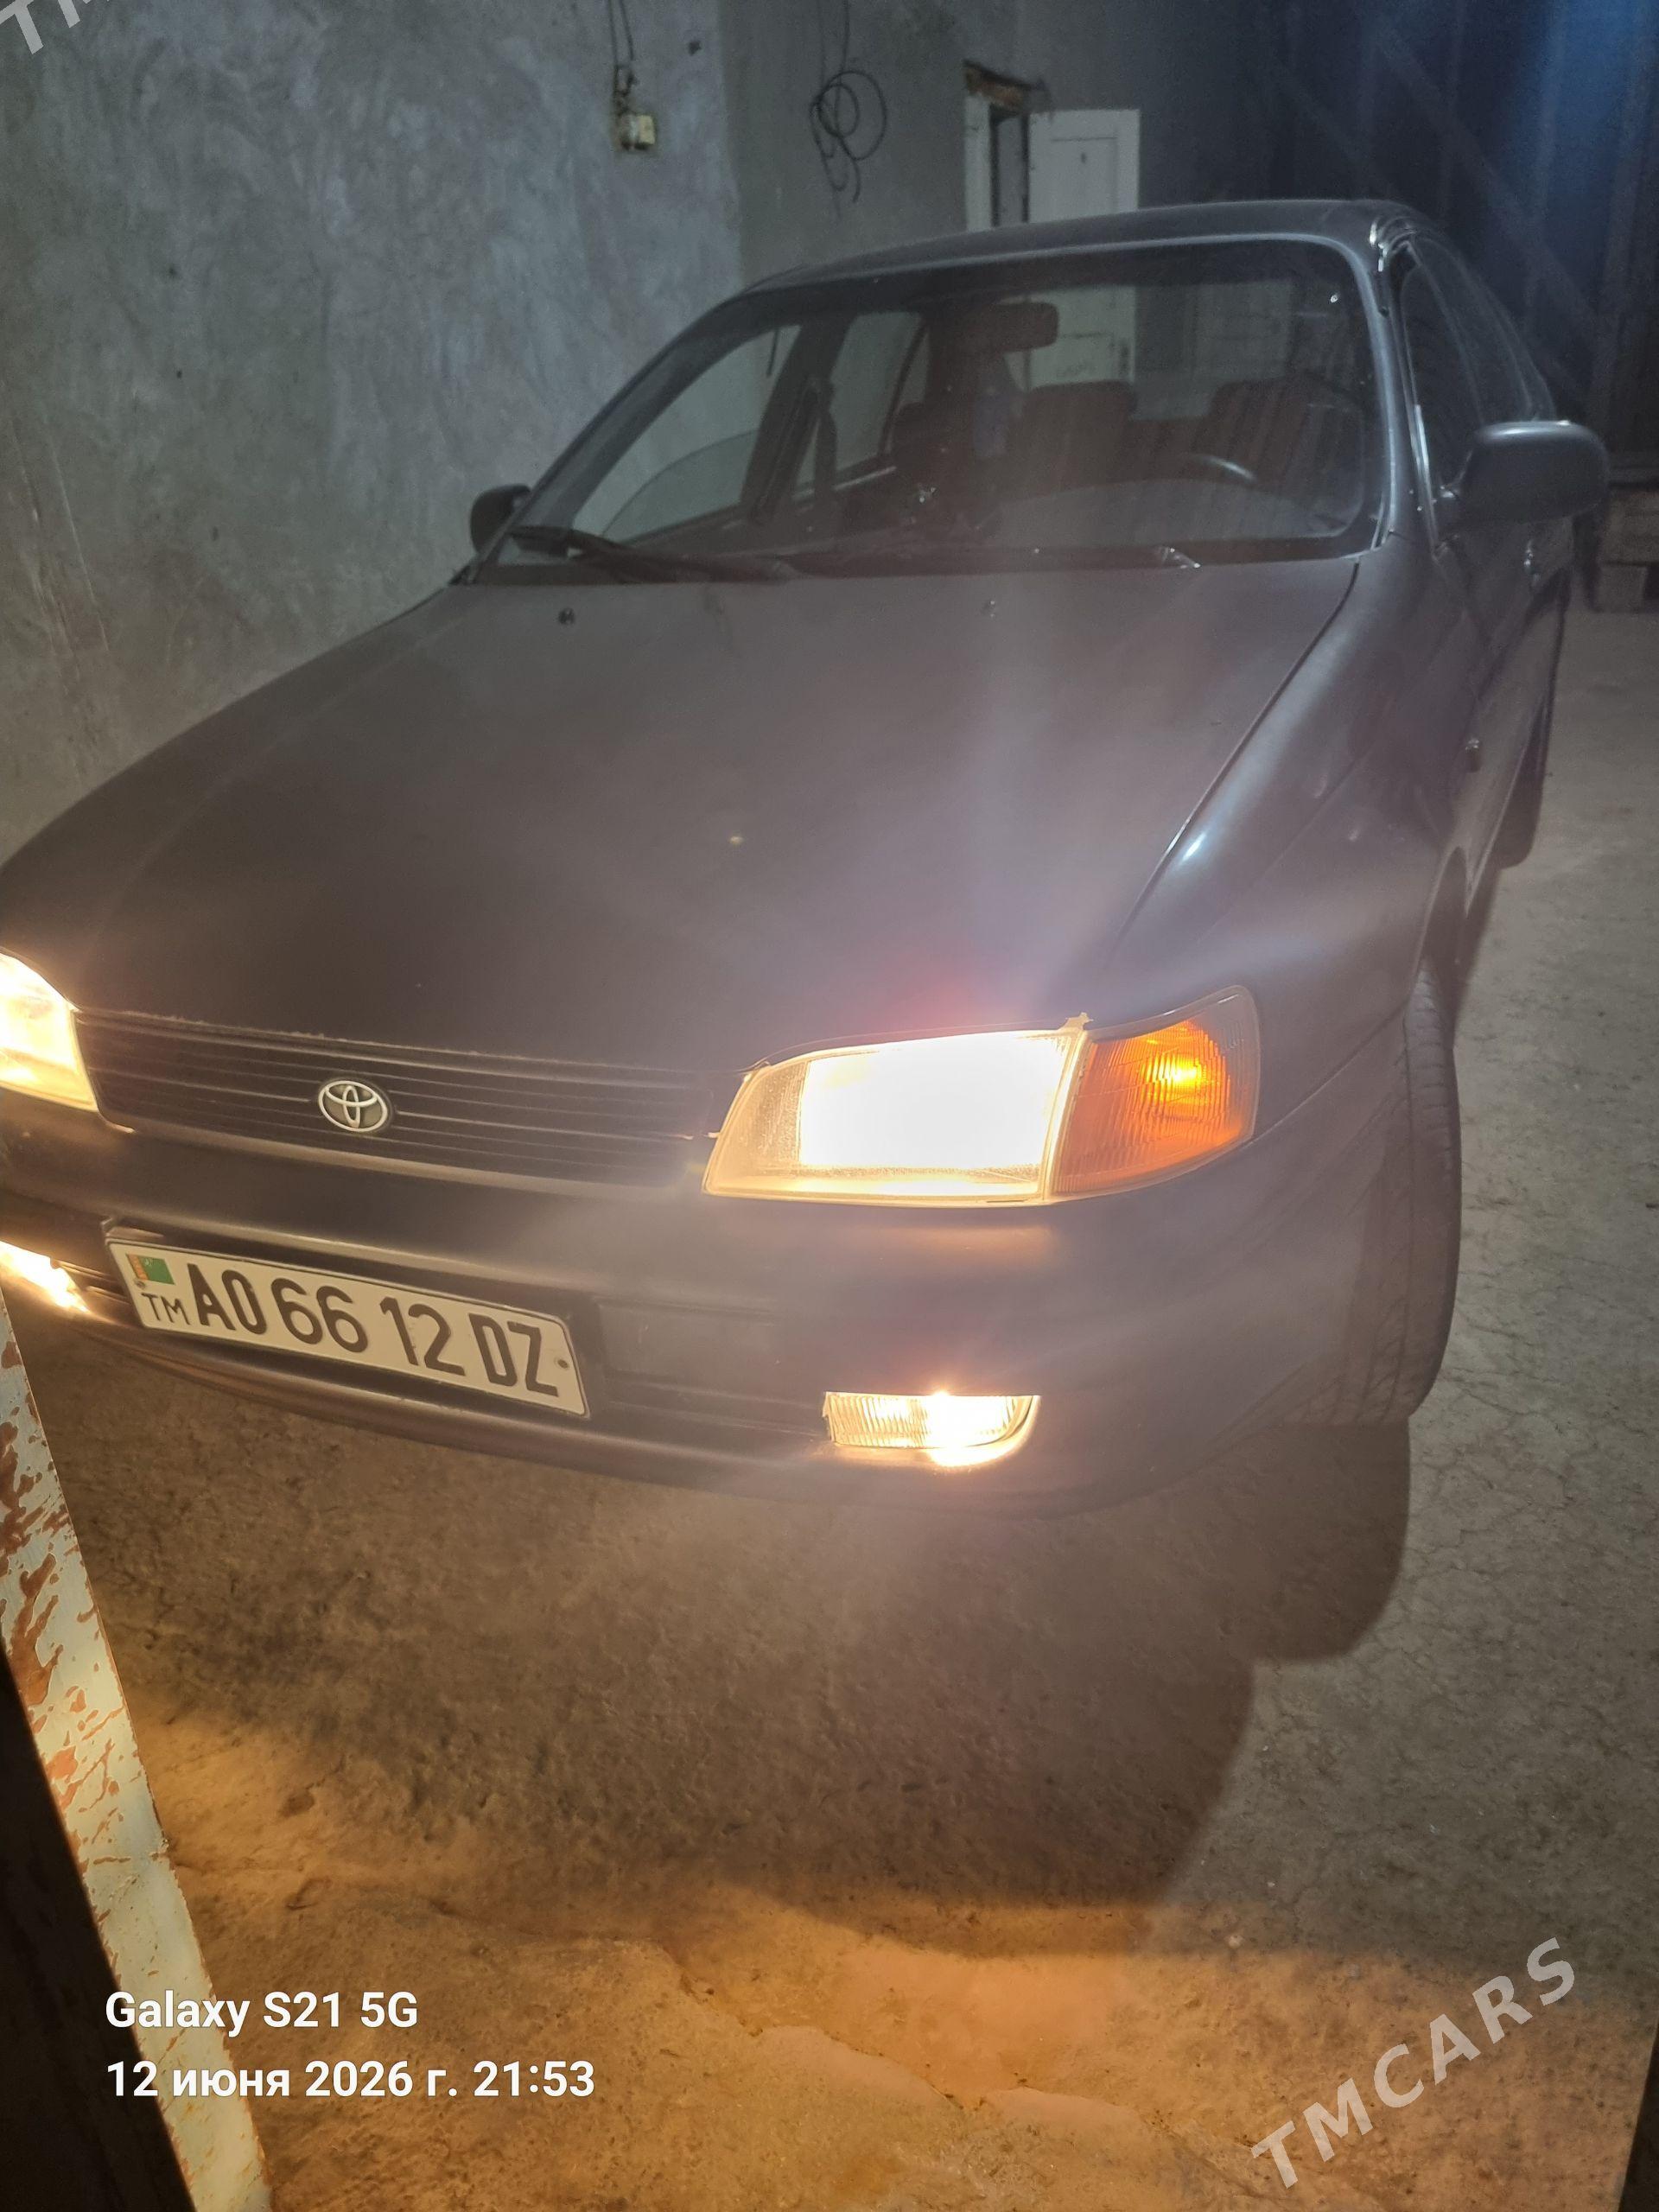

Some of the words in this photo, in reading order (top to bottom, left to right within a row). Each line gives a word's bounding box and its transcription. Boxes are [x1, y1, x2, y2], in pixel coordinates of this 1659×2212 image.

[142, 1293, 190, 1326] TM
[270, 1278, 368, 1353] 66
[379, 1297, 466, 1376] 12
[468, 1313, 559, 1397] DZ
